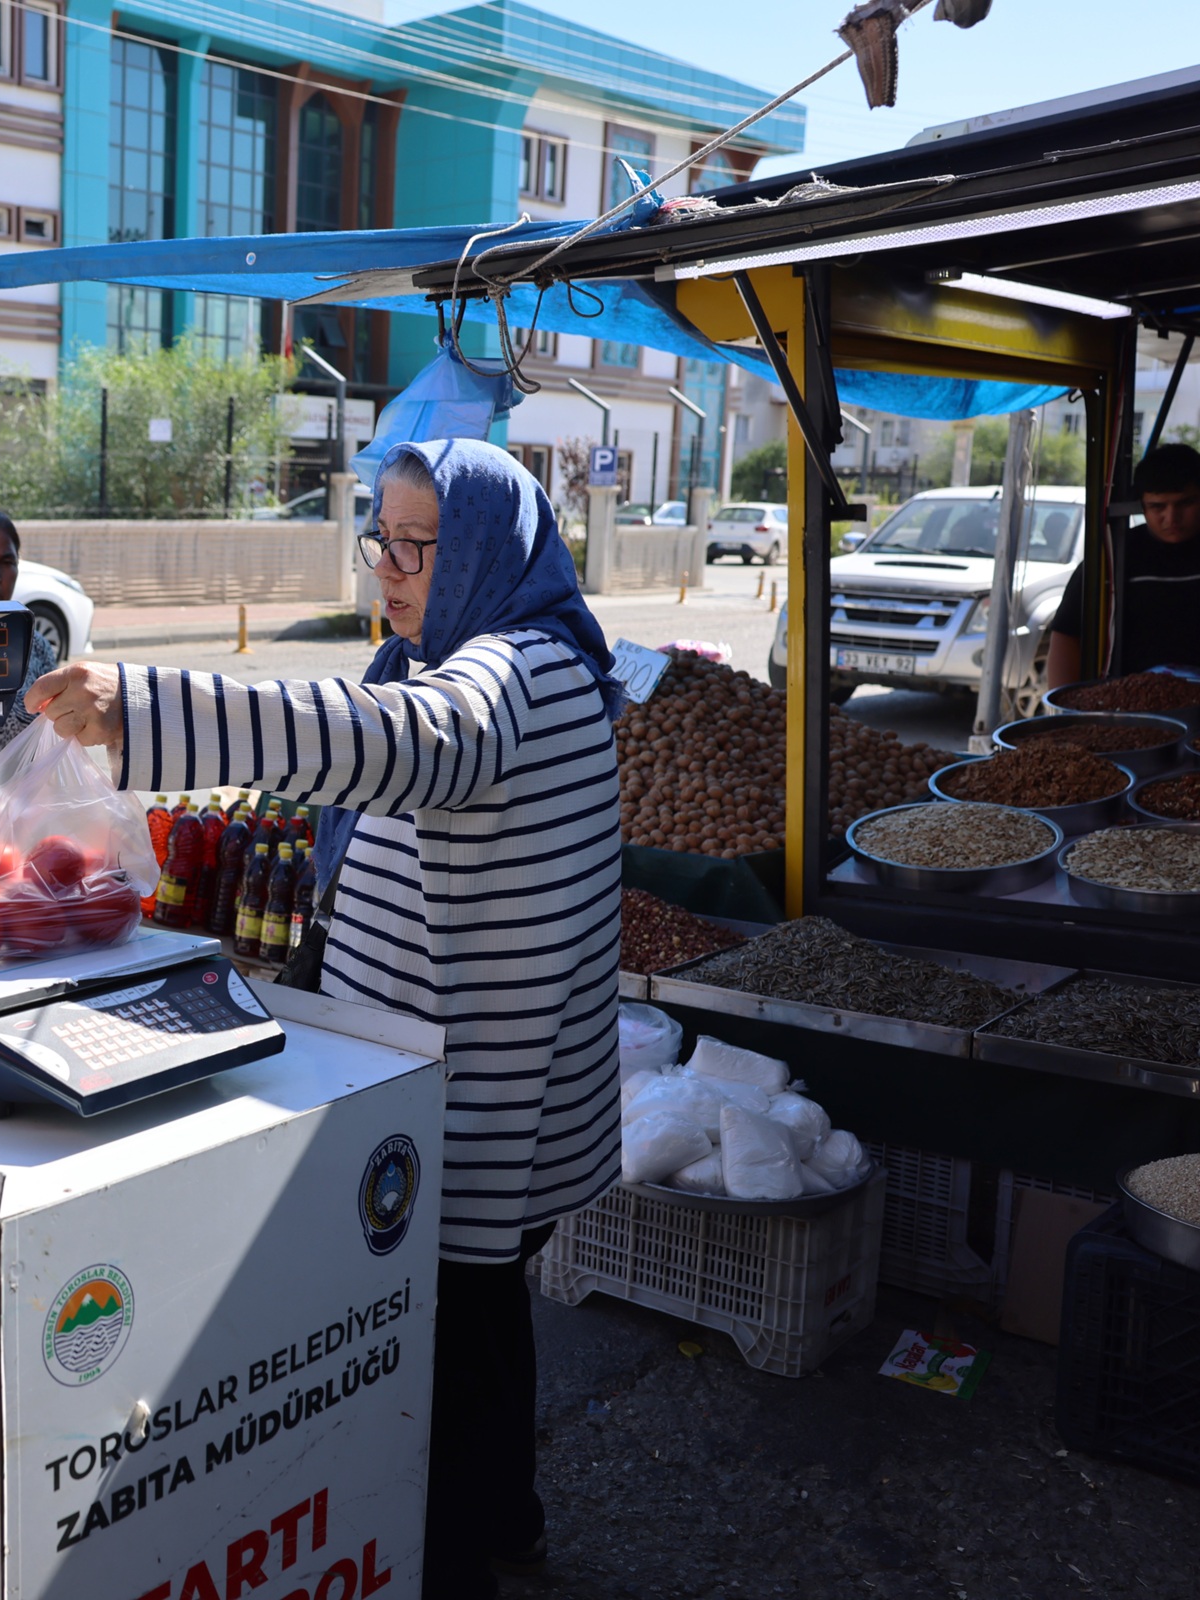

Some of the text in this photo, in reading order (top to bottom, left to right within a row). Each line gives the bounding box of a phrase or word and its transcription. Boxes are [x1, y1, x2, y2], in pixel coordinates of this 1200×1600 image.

[595, 450, 614, 471] P
[374, 1141, 408, 1167] ZABITA
[56, 1267, 106, 1307] TOROSLAR
[107, 1268, 133, 1326] BELEDİYESİ
[44, 1278, 411, 1492] TOROSLAR BELEDİYESİ
[56, 1341, 401, 1553] ZABITA MÜDÜRLÜĞÜ
